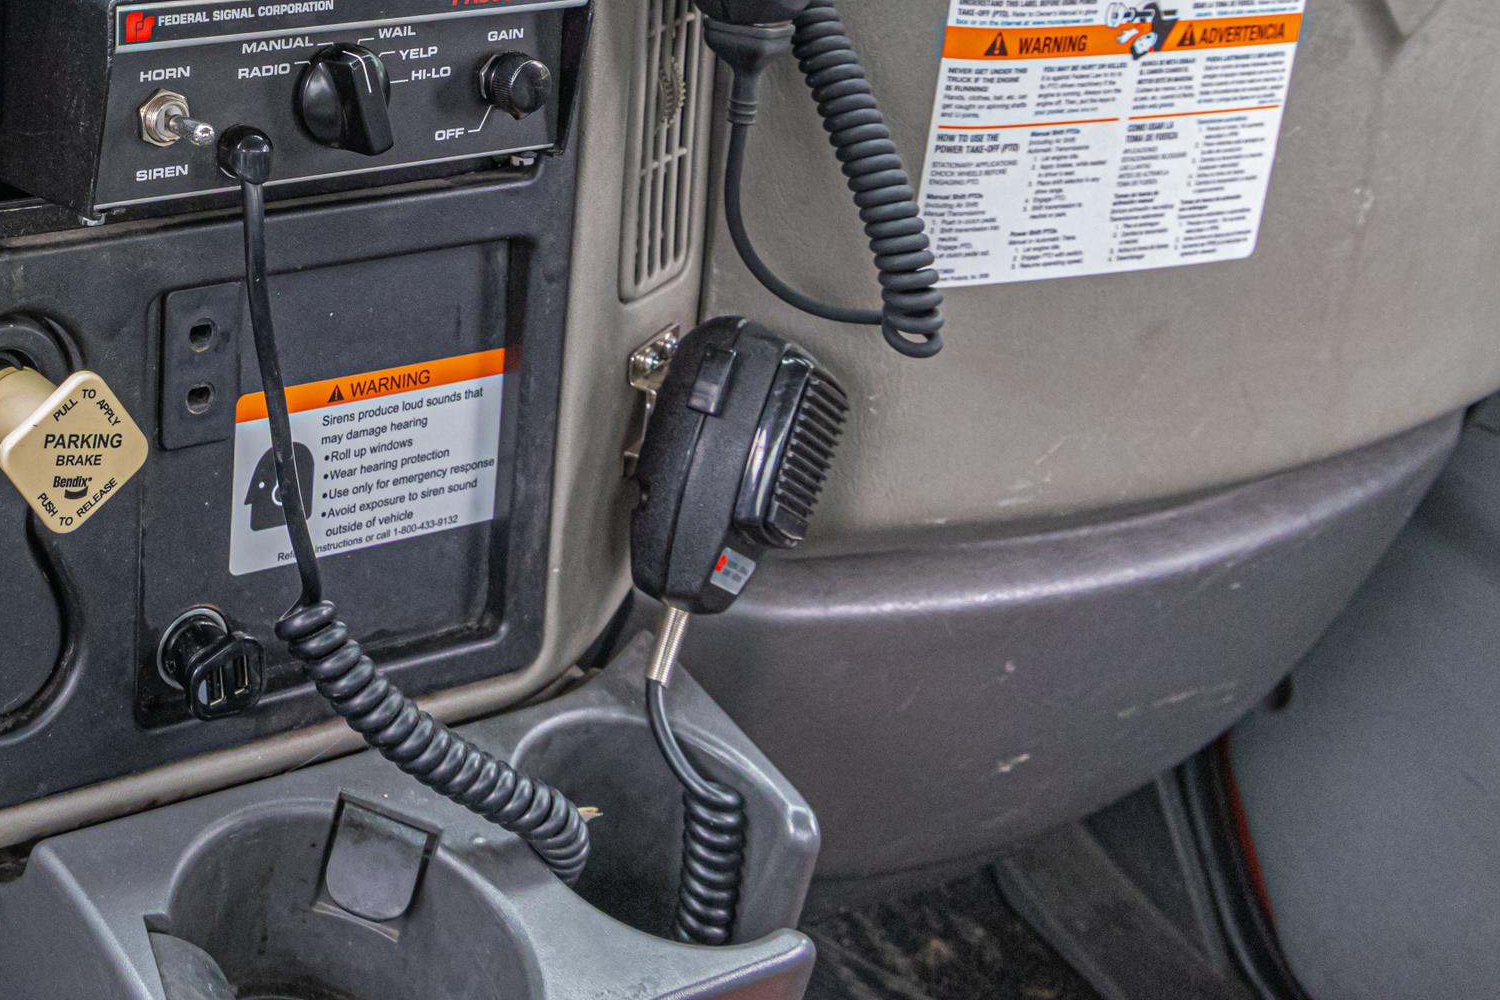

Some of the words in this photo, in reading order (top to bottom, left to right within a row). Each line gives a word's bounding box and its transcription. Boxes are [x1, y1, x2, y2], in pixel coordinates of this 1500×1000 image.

[157, 11, 210, 27] FEDERAL
[213, 6, 255, 21] SIGNAL
[258, 0, 334, 17] CORPORATION
[378, 25, 416, 39] WAIL
[487, 28, 524, 42] GAIN
[1199, 22, 1286, 45] ADVERTENCIA
[241, 36, 314, 54] MANUAL
[399, 46, 438, 61] YELP
[1018, 34, 1088, 55] WARNING
[139, 65, 191, 83] HORN
[237, 62, 291, 80] RADIO
[411, 66, 451, 81] HI-LO
[434, 127, 465, 141] OFF
[936, 133, 956, 142] HOW
[958, 134, 968, 142] TO
[970, 134, 984, 142] USE
[986, 133, 999, 142] THE
[934, 144, 963, 153] POWER
[966, 144, 999, 153] TAKE-OFF
[136, 164, 189, 182] SIREN
[350, 369, 431, 397] WARNING
[53, 398, 78, 421] PULL
[81, 388, 97, 399] TO
[96, 399, 121, 427] APPLY
[322, 411, 355, 427] Sirens
[358, 403, 400, 422] produce
[402, 399, 424, 412] loud
[426, 391, 462, 407] sounds
[464, 387, 484, 400] that
[44, 433, 123, 449] PARKING
[321, 433, 343, 446] may
[346, 423, 387, 440] damage
[390, 416, 428, 432] hearing
[354, 447, 367, 458] up
[369, 437, 413, 453] windows
[55, 454, 102, 466] BRAKE
[329, 467, 357, 480] Wear
[360, 459, 398, 475] hearing
[400, 449, 450, 468] protection
[352, 482, 373, 495] only
[376, 477, 390, 489] for
[392, 467, 448, 487] emergency
[450, 457, 495, 475] response
[37, 492, 59, 517] PUSH
[59, 516, 74, 526] TO
[76, 478, 118, 518] RELEASE
[326, 504, 356, 519] Avoid
[359, 494, 405, 511] exposure
[408, 491, 418, 502] to
[420, 486, 445, 499] siren
[447, 478, 478, 494] sound
[325, 521, 363, 537] outside
[365, 517, 377, 529] of
[378, 509, 414, 526] vehicle
[365, 532, 375, 542] or
[376, 528, 391, 540] call
[393, 514, 459, 537] 1-800-433-9132
